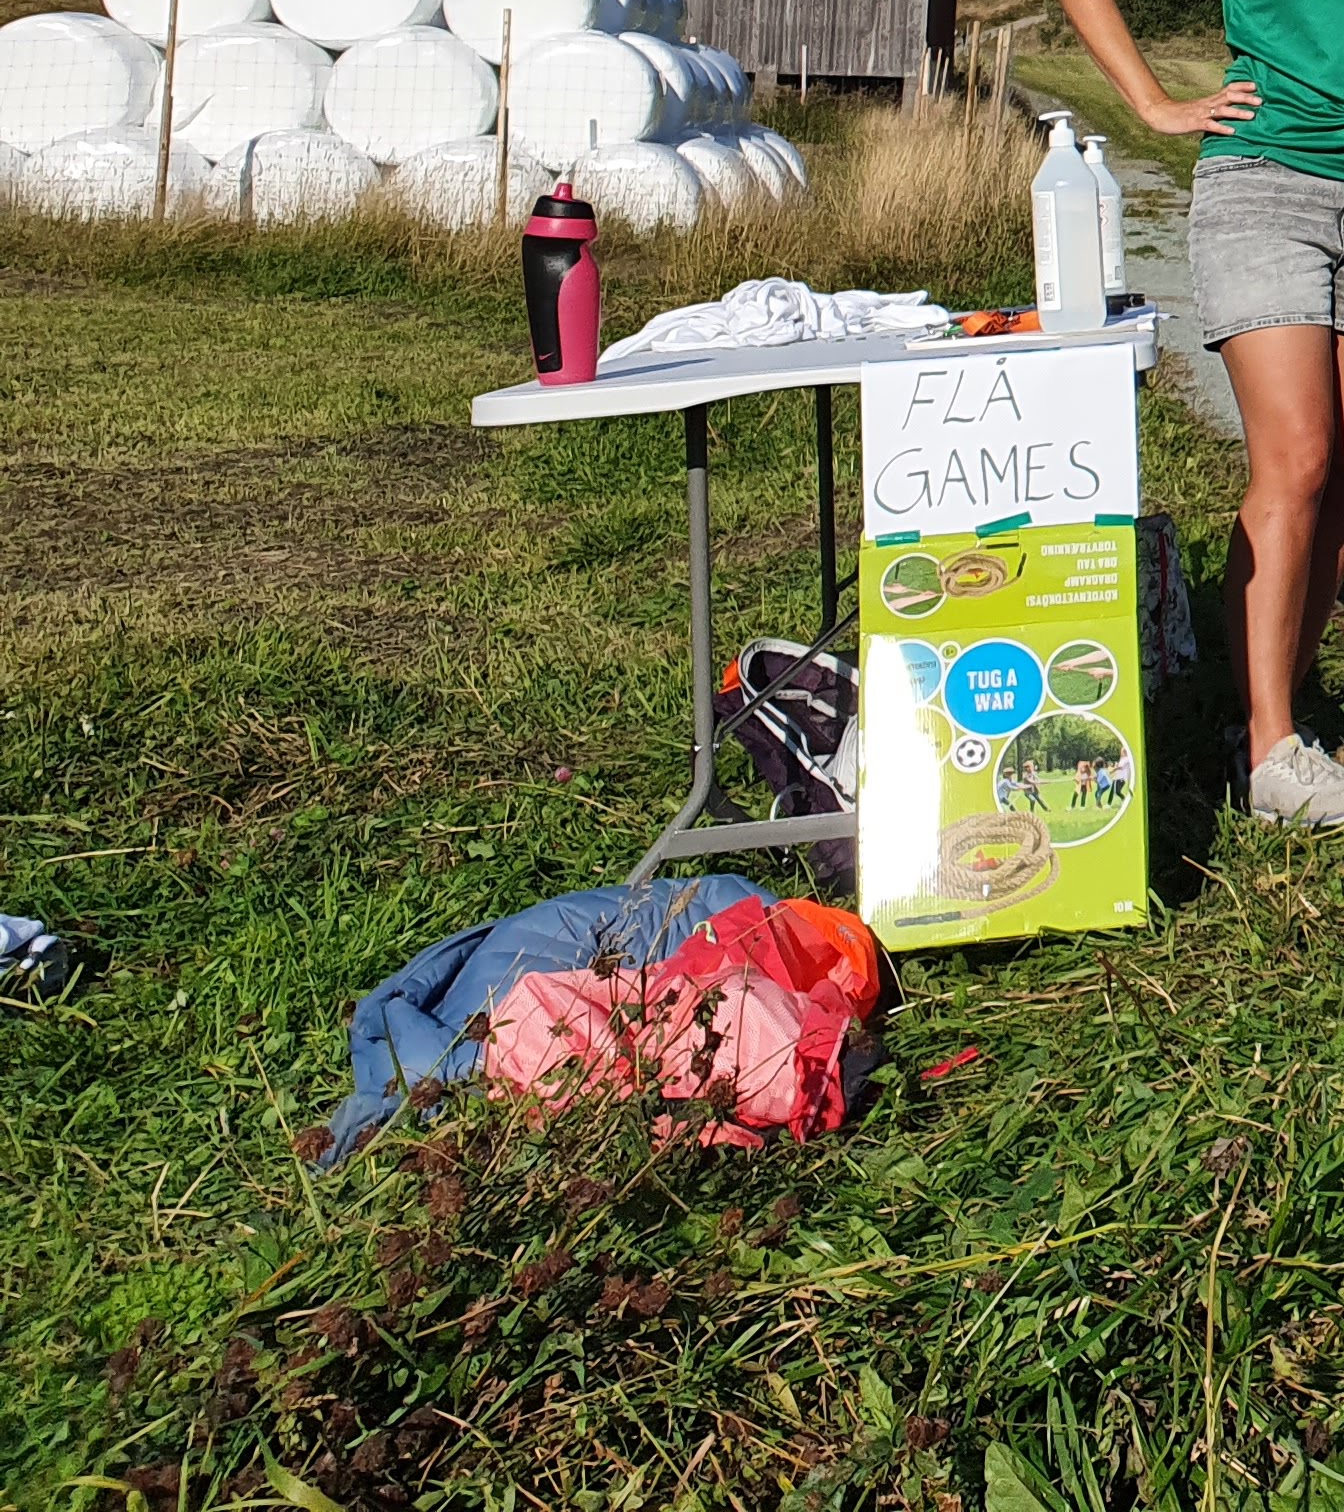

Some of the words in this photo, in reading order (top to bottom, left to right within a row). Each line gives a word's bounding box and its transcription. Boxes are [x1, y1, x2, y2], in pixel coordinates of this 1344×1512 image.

[901, 357, 1022, 430] FLÅ
[873, 440, 1101, 515] GAMES
[966, 669, 1003, 690] TUG
[1006, 668, 1018, 687] A
[974, 691, 1016, 713] WAR
